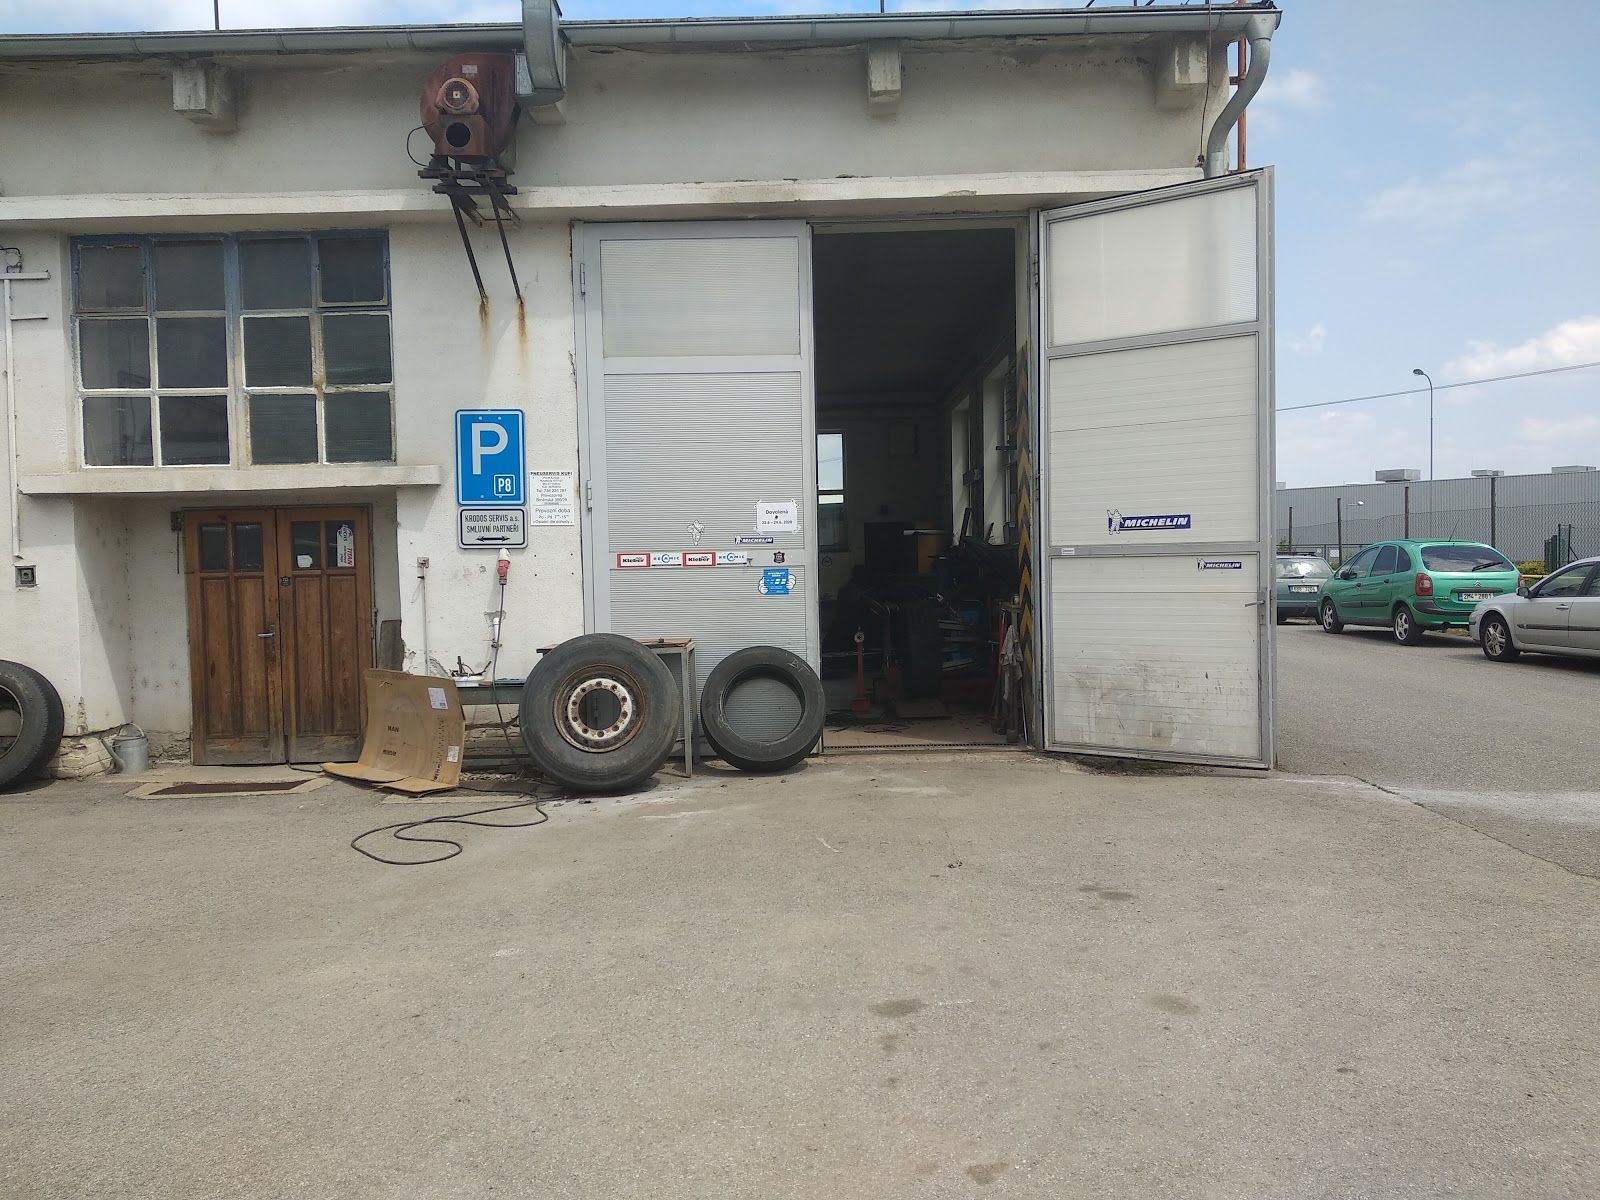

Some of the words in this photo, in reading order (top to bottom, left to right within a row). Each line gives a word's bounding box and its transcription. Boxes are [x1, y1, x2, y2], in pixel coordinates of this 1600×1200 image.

[471, 422, 509, 475] P
[498, 478, 512, 493] P8
[465, 514, 488, 522] KRODOS
[488, 514, 509, 522] SERVIS
[1124, 516, 1188, 527] MICHELIN
[466, 523, 492, 533] SMLUVNÍ
[492, 522, 519, 533] PARTNEŘI
